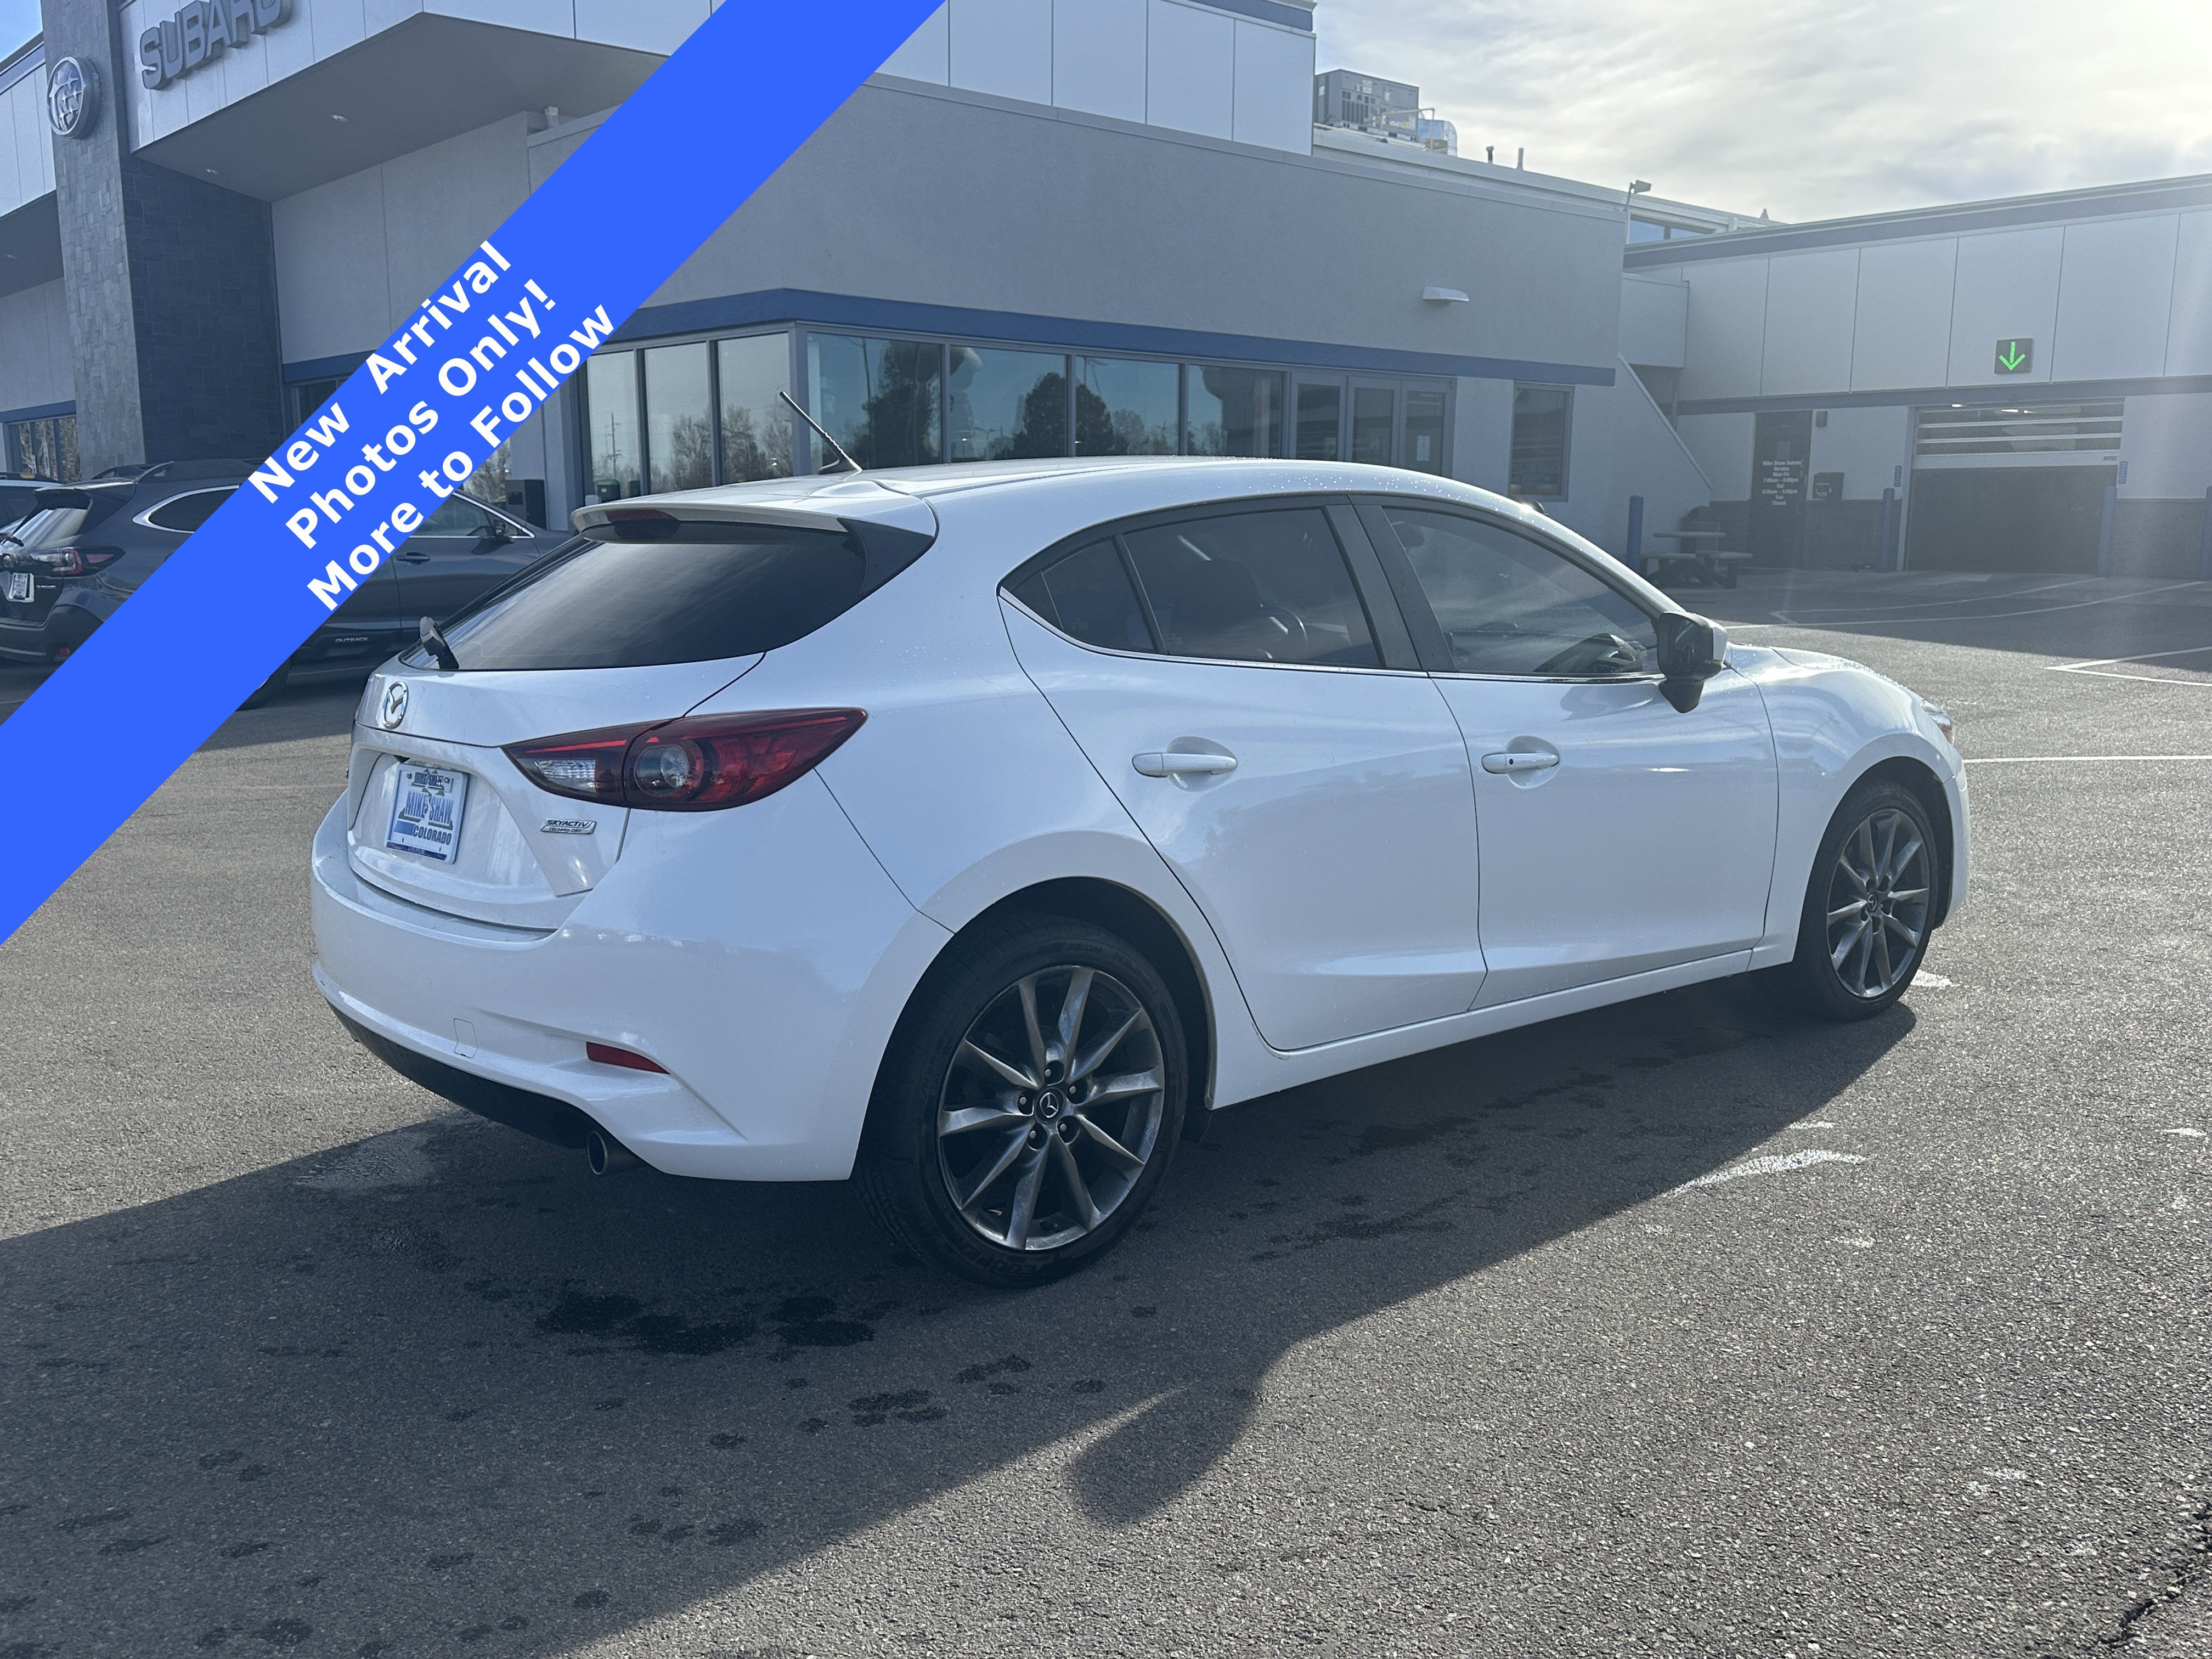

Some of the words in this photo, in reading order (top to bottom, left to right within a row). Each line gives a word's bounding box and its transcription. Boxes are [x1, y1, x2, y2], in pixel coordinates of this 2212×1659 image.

[405, 791, 428, 819] MIKE
[429, 795, 454, 824] SHAW
[413, 825, 452, 845] COLORADO
[1066, 943, 1103, 953] ZEON
